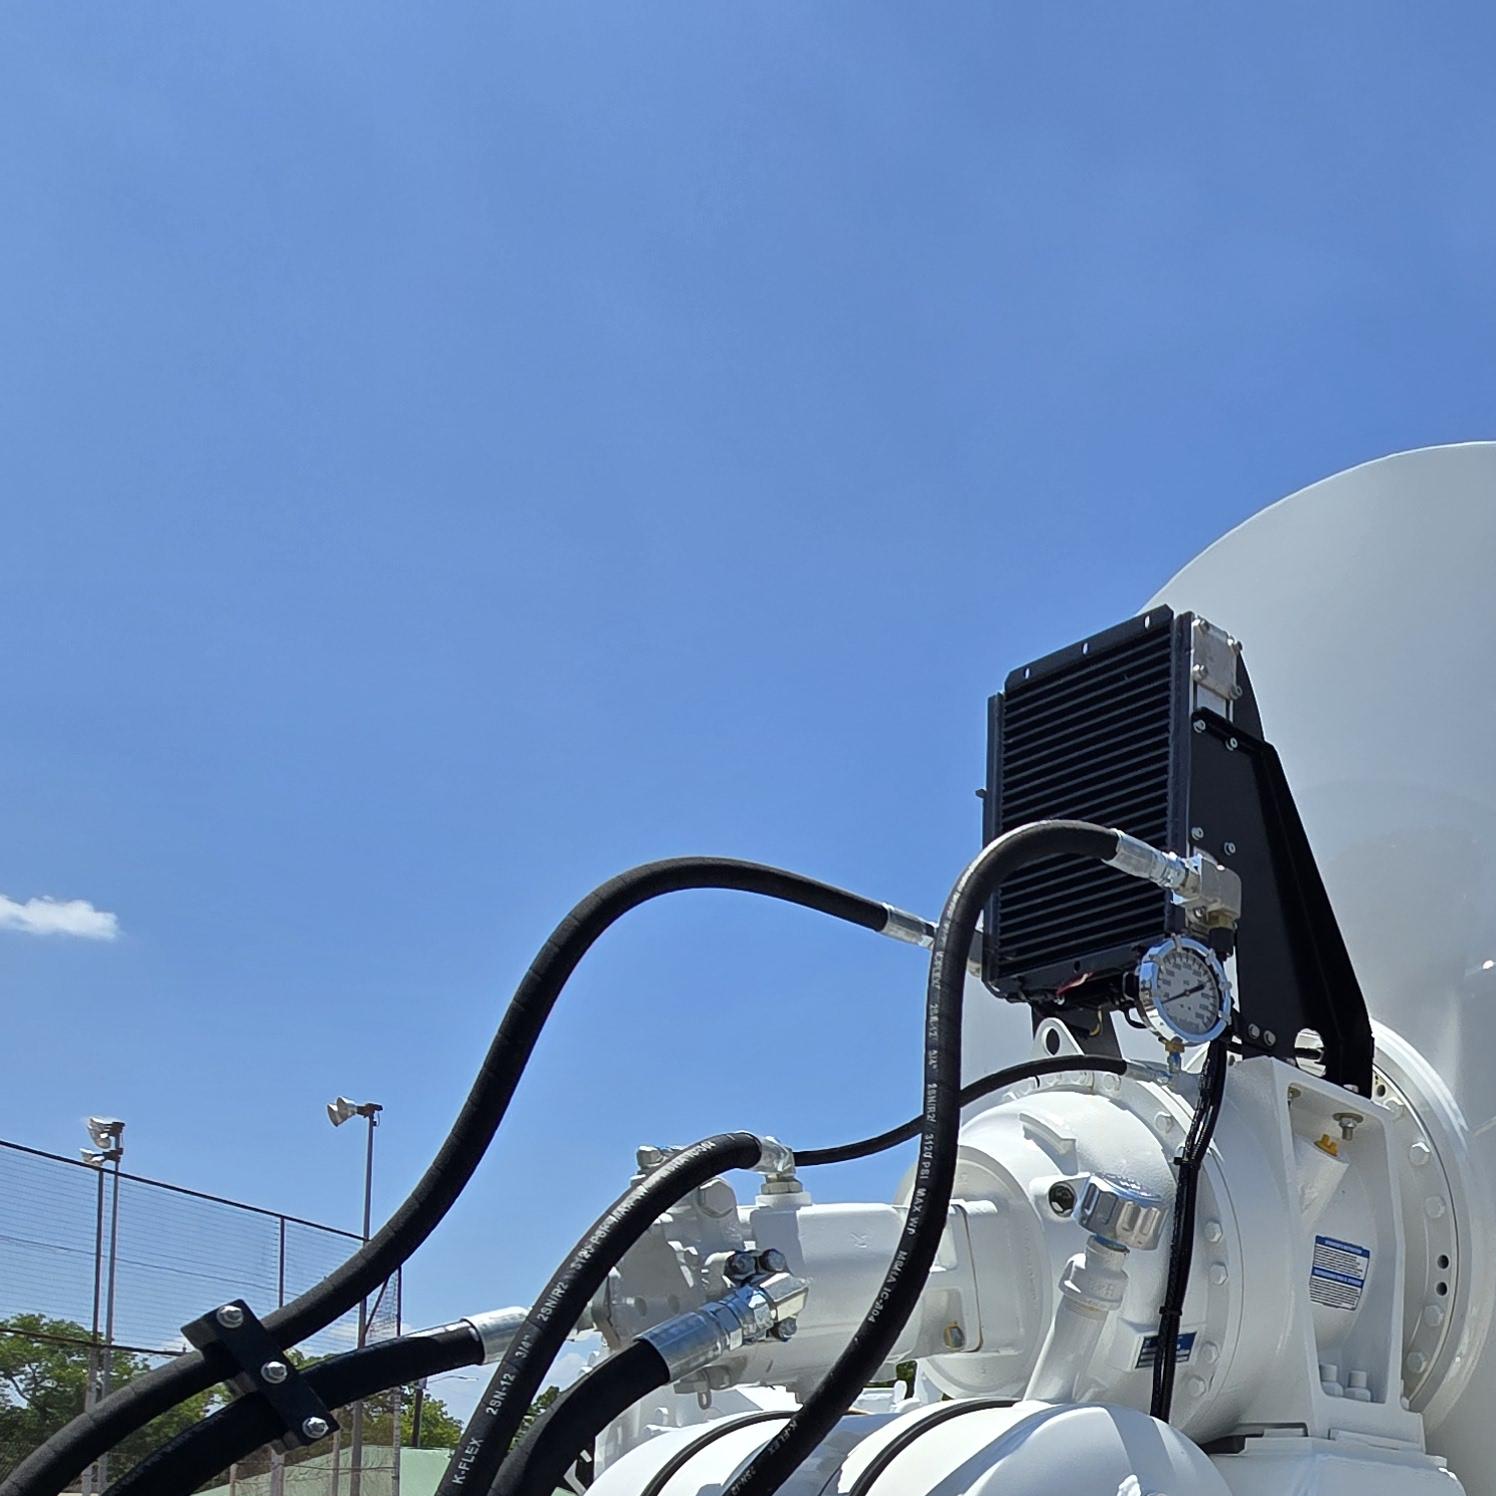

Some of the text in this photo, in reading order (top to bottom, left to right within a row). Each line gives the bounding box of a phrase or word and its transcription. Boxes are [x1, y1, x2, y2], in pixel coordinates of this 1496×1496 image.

[913, 1188, 927, 1214] MAX
[452, 1437, 485, 1485] K-FLEX
[485, 1372, 516, 1416] 2SN-12
[515, 1334, 533, 1359] 3/4"
[537, 1281, 569, 1322] 2SN/R2
